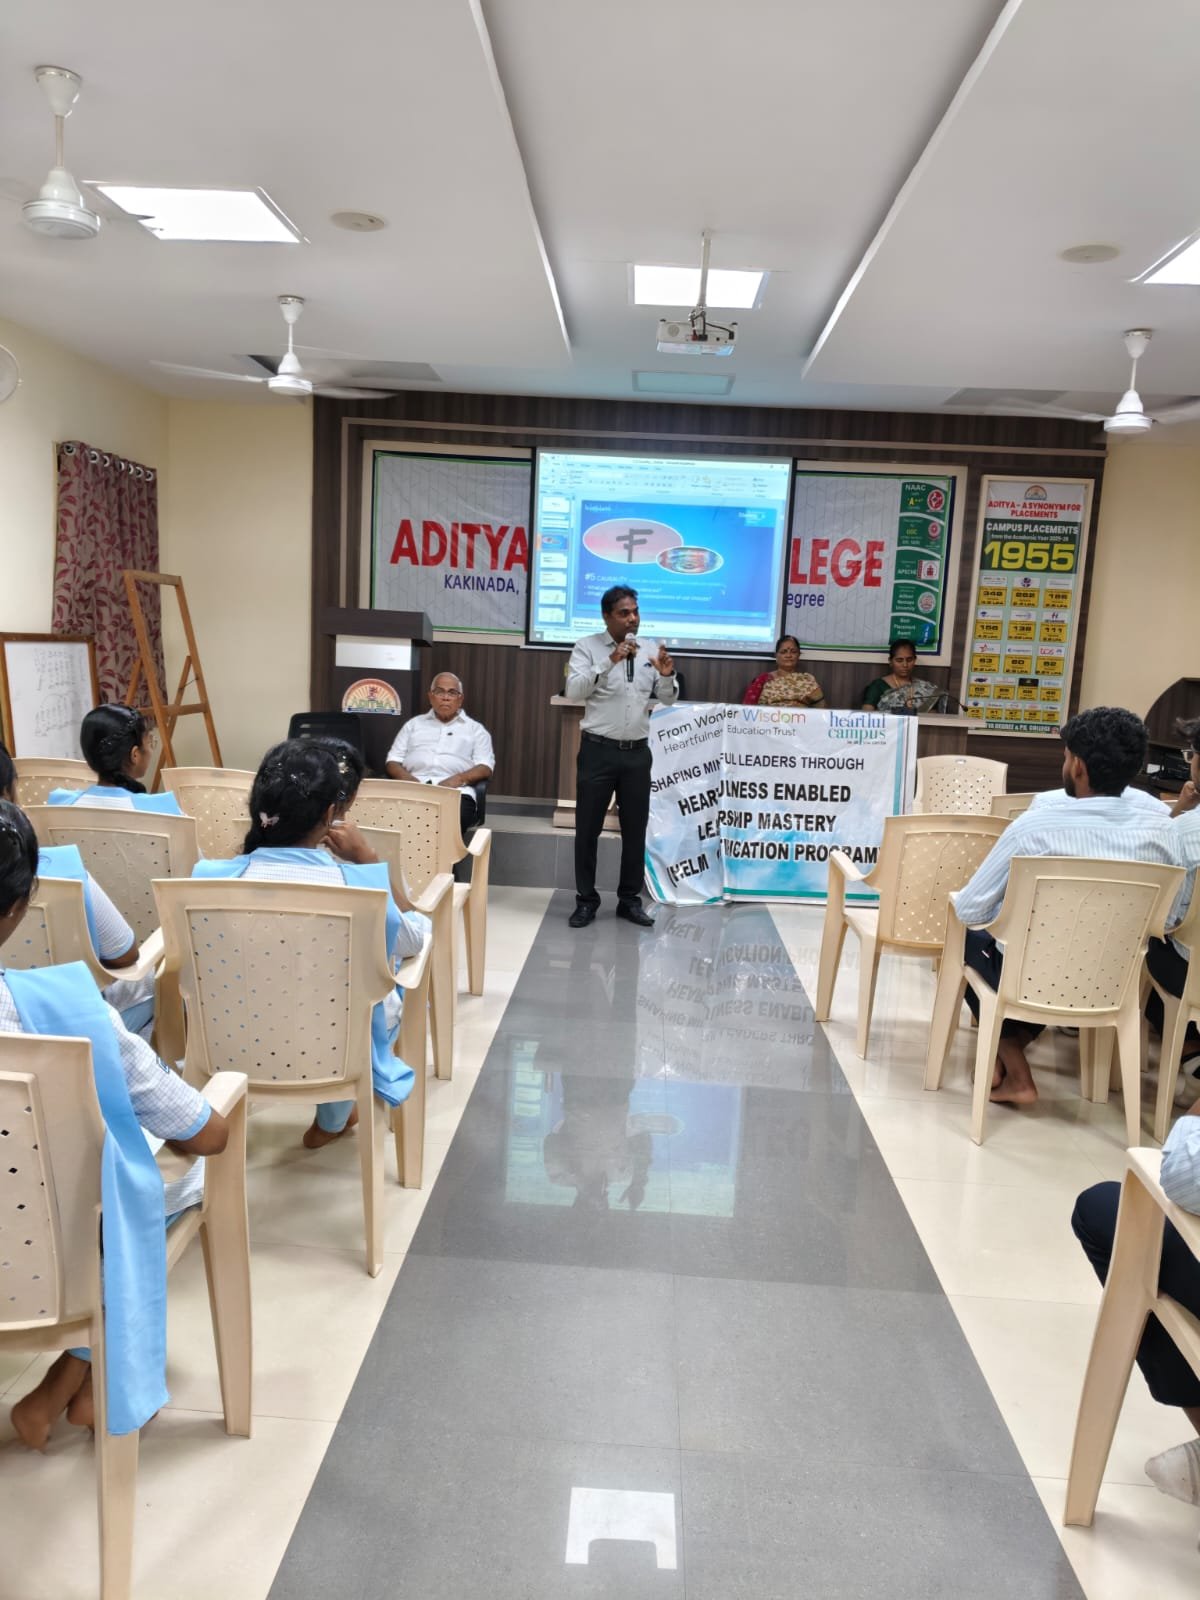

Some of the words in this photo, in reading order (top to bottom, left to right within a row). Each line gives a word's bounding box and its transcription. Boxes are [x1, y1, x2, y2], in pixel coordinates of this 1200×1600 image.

[1010, 510, 1058, 518] PLACEMENTS
[1028, 502, 1066, 511] SYNONYM
[986, 522, 1022, 532] CAMPUS
[1024, 524, 1079, 534] PLACEMENTS
[389, 519, 528, 572] ADITYA
[790, 538, 885, 588] LEGE
[984, 541, 1075, 571] 1955
[444, 574, 520, 595] KAKINADA,
[786, 593, 824, 608] egree
[657, 722, 692, 742] From
[742, 708, 806, 724] Wisdom
[664, 729, 723, 754] Heartfulne
[727, 725, 772, 736] Education
[773, 727, 796, 736] Trust
[828, 728, 886, 746] campus
[650, 766, 702, 792] SHAPING
[738, 754, 797, 768] LEADERS
[801, 756, 864, 770] THROUGH
[774, 782, 850, 802] ENABLED
[758, 812, 836, 832] MASTERY
